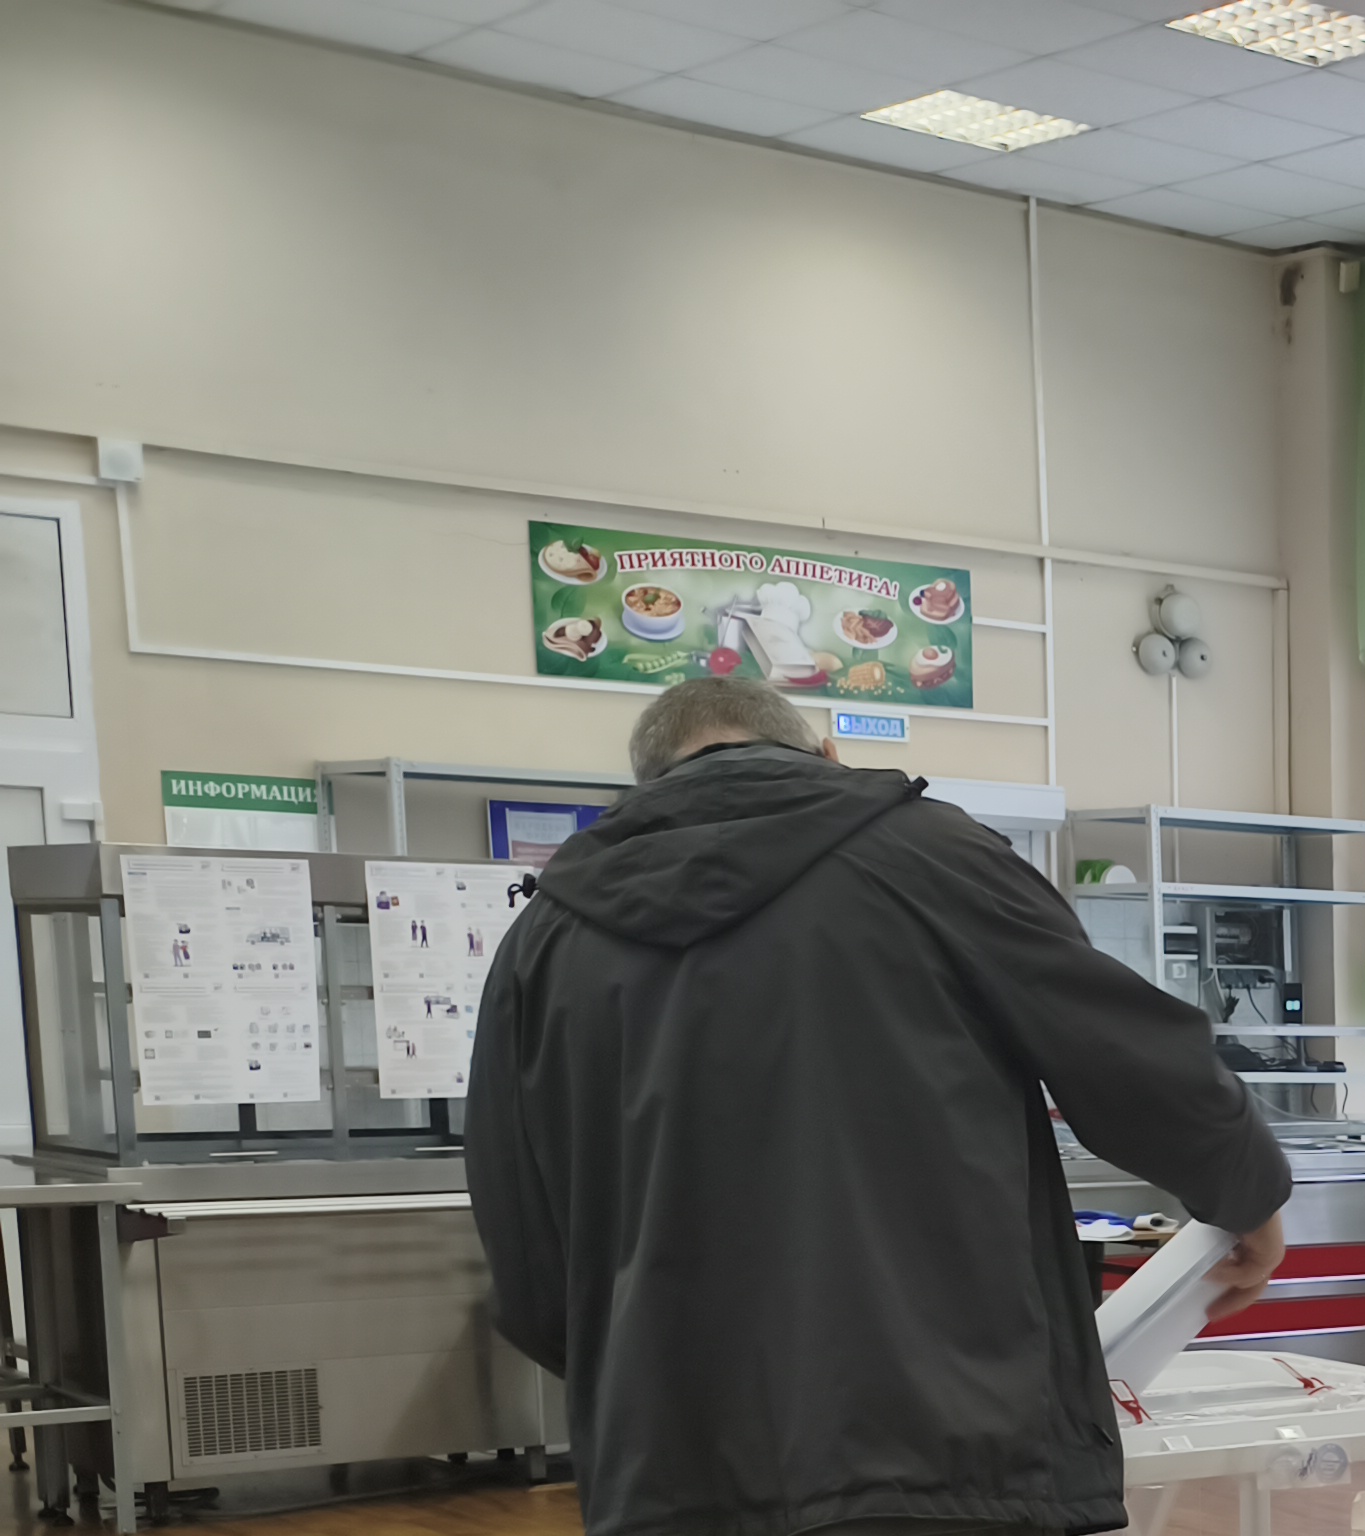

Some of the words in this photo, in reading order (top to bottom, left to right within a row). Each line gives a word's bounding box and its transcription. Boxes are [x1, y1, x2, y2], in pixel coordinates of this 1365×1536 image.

[617, 551, 765, 571] ПРИЯТНОГО
[770, 556, 899, 599] АППЕТИТА!
[839, 714, 903, 737] ВЫХОД
